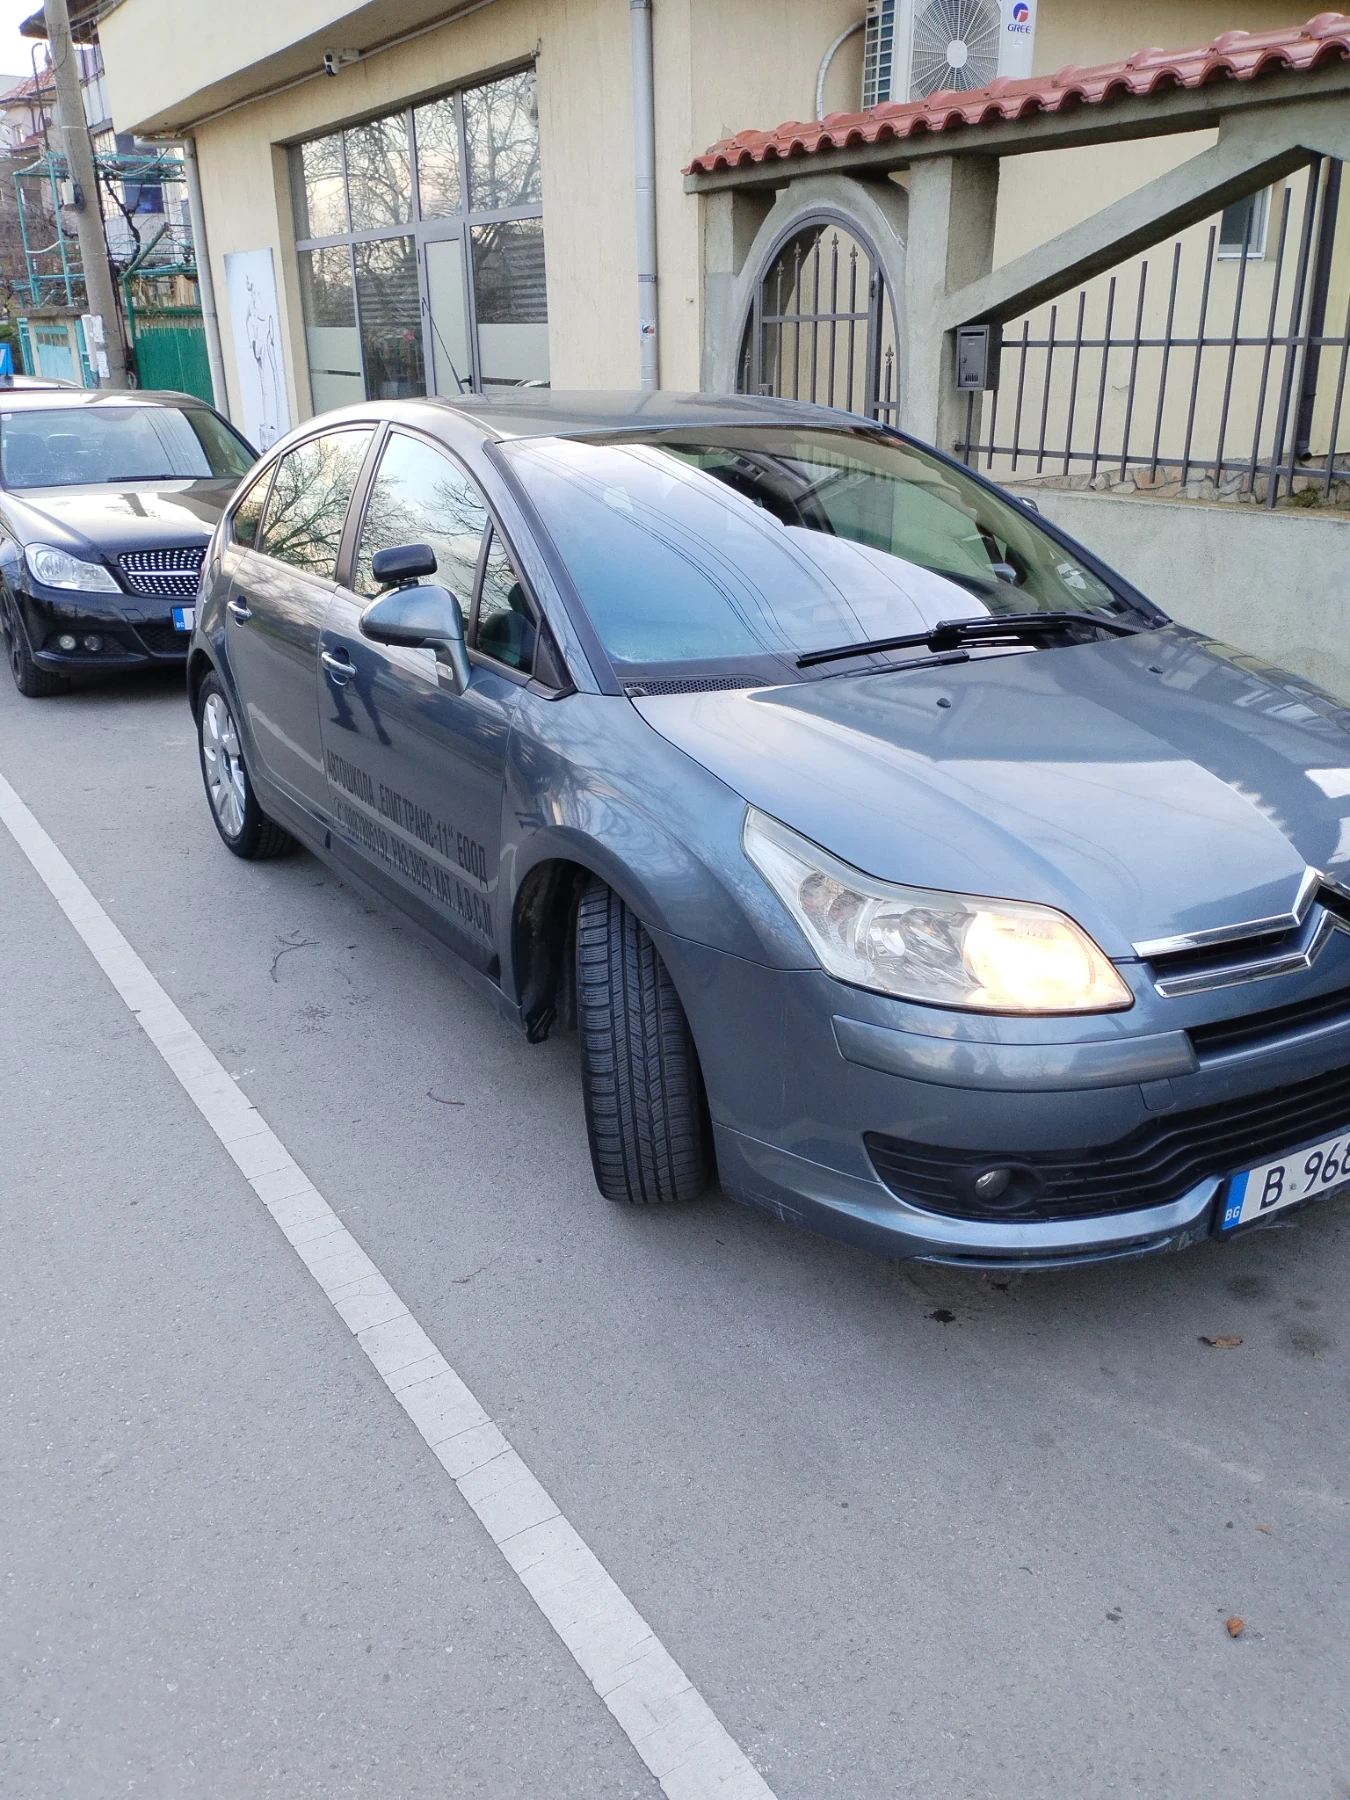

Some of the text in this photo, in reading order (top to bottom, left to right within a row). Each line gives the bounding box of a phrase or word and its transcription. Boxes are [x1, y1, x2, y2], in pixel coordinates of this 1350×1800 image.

[1008, 23, 1031, 34] GREE
[326, 748, 376, 810] АВТОШКОЛА
[456, 831, 489, 892] ЕООД
[1260, 1165, 1285, 1210] B
[1225, 1206, 1240, 1221] BG
